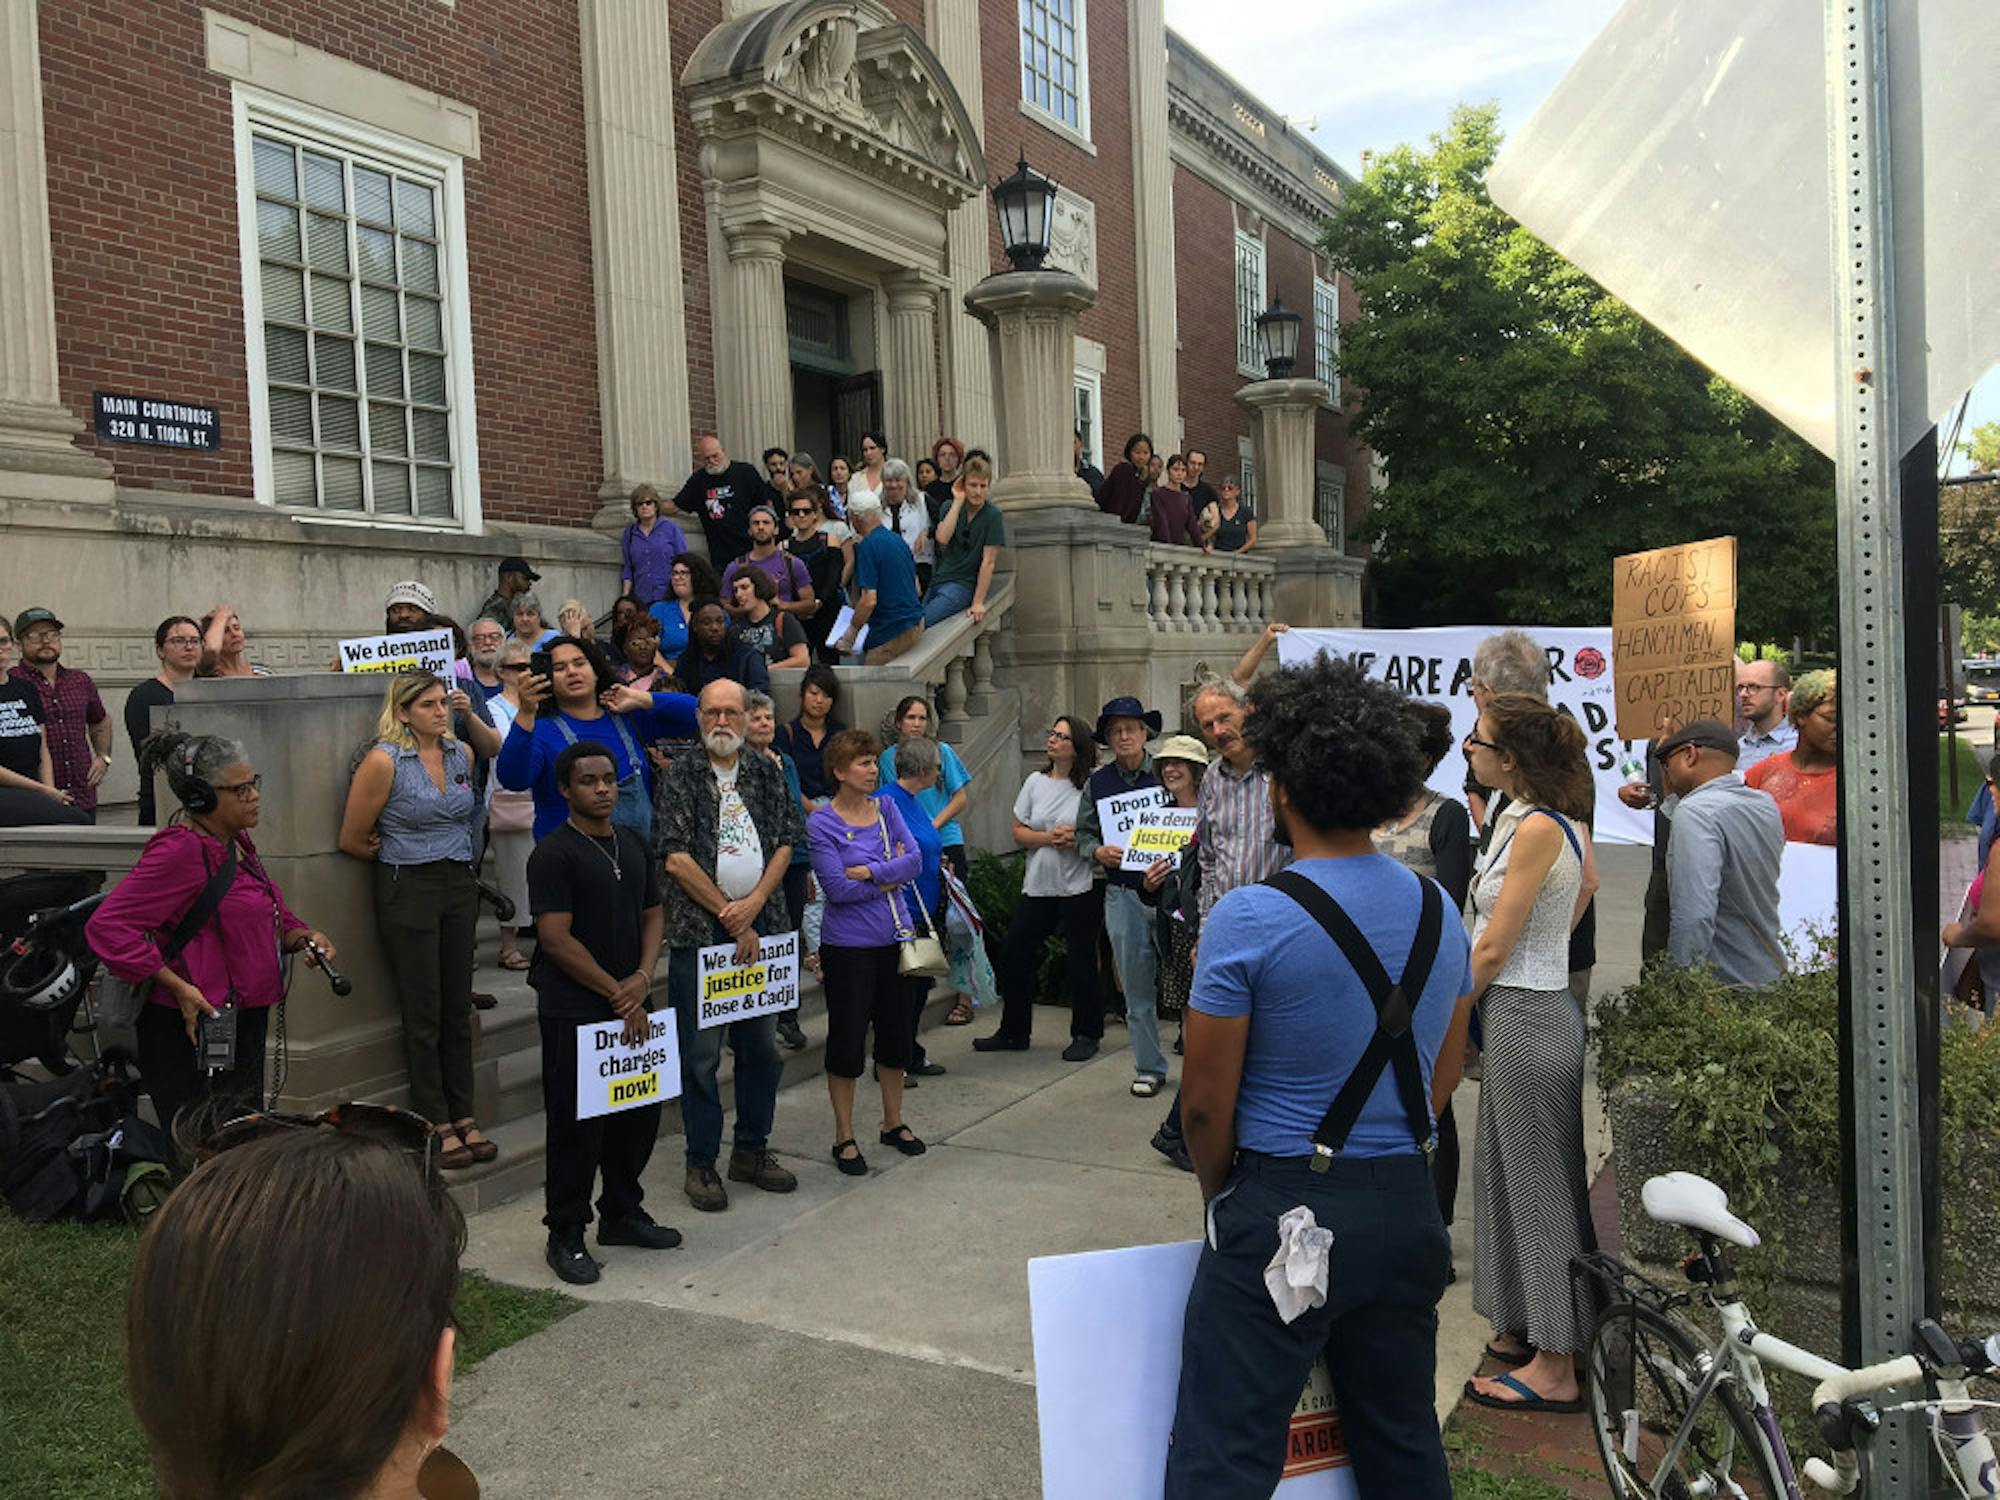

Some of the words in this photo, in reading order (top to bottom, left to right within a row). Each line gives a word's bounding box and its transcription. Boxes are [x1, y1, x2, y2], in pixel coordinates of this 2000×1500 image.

[102, 397, 137, 415] MAIN
[143, 401, 212, 425] COURTHOUSE
[109, 419, 135, 437] 320
[140, 423, 153, 439] N.
[156, 425, 189, 443] TIOGA
[1625, 547, 1719, 588] RACIST
[344, 644, 372, 661] We
[378, 633, 450, 658] demand
[1614, 618, 1717, 662] HENCHMEN
[421, 656, 447, 673] for
[1684, 653, 1700, 665] OF
[1703, 647, 1726, 662] THE
[1384, 655, 1442, 696] ARE
[1626, 665, 1733, 704] CAPITALIST
[1653, 699, 1724, 732] ORDER
[1154, 789, 1175, 805] th
[1139, 811, 1160, 827] We
[1162, 811, 1198, 828] dem
[1132, 829, 1189, 847] justice
[703, 952, 726, 972] We
[704, 969, 764, 1000] justice
[767, 963, 791, 983] for
[702, 999, 739, 1020] Rose
[742, 993, 754, 1010] &
[758, 984, 795, 1006] Cadji
[600, 1048, 667, 1078] charges
[613, 1073, 657, 1102] now!
[1291, 1426, 1341, 1458] ARGE
